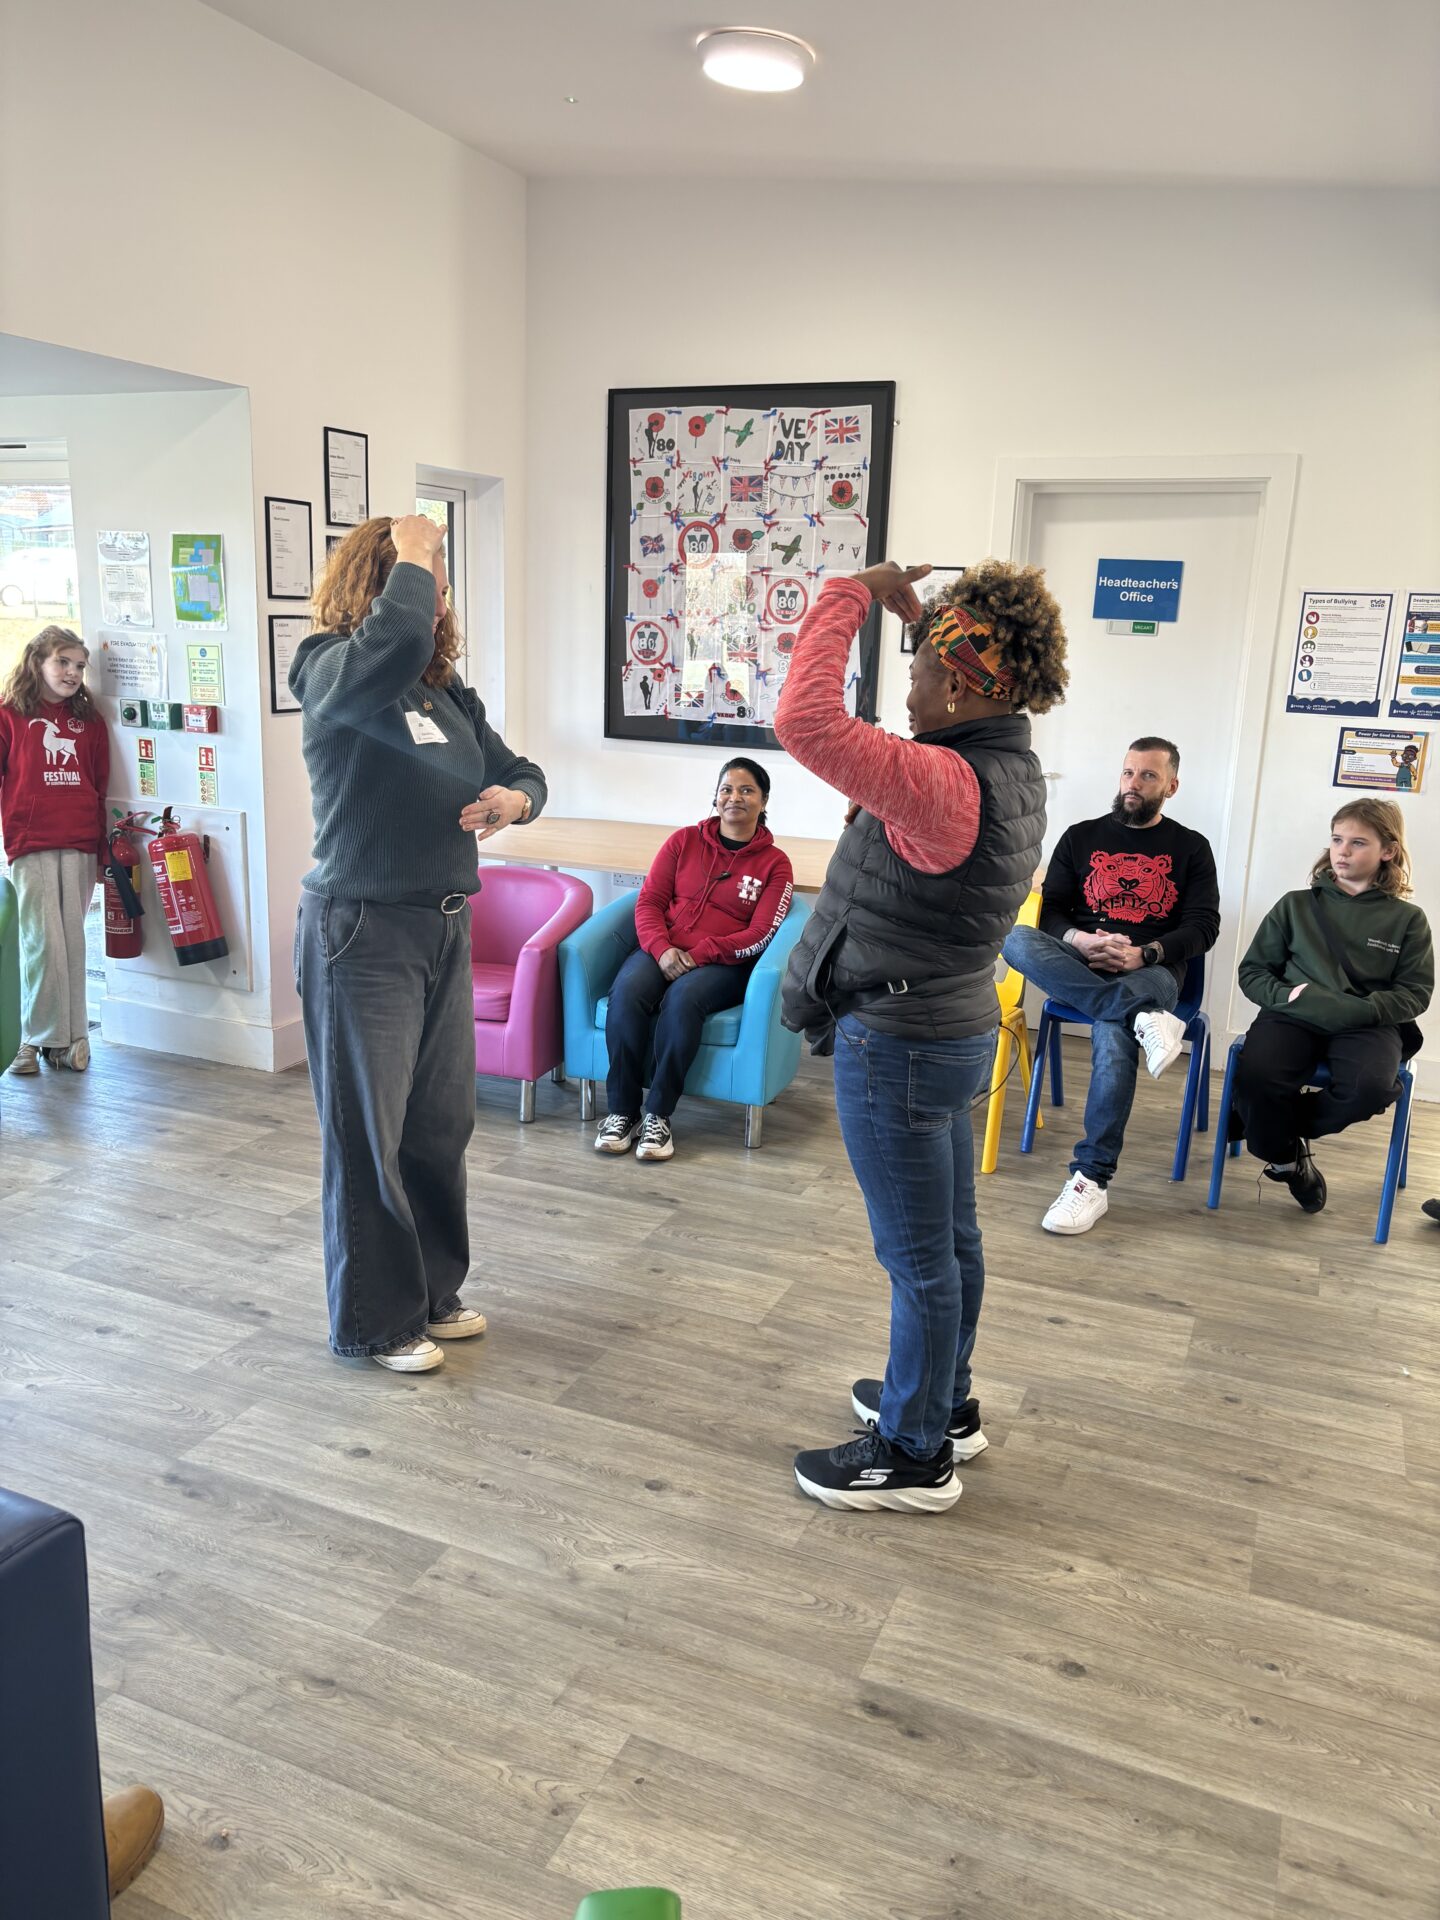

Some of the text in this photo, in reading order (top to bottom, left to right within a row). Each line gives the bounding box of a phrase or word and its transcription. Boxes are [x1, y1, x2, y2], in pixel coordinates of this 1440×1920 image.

[780, 418, 806, 439] VE
[657, 438, 675, 451] 80
[774, 440, 811, 461] DAY
[1099, 576, 1179, 590] Headteacher's
[778, 596, 796, 609] 80
[1119, 591, 1154, 603] Office
[43, 771, 81, 782] FESTIVAL
[773, 881, 793, 929] HOLLISTER
[1098, 896, 1163, 914] KENZO
